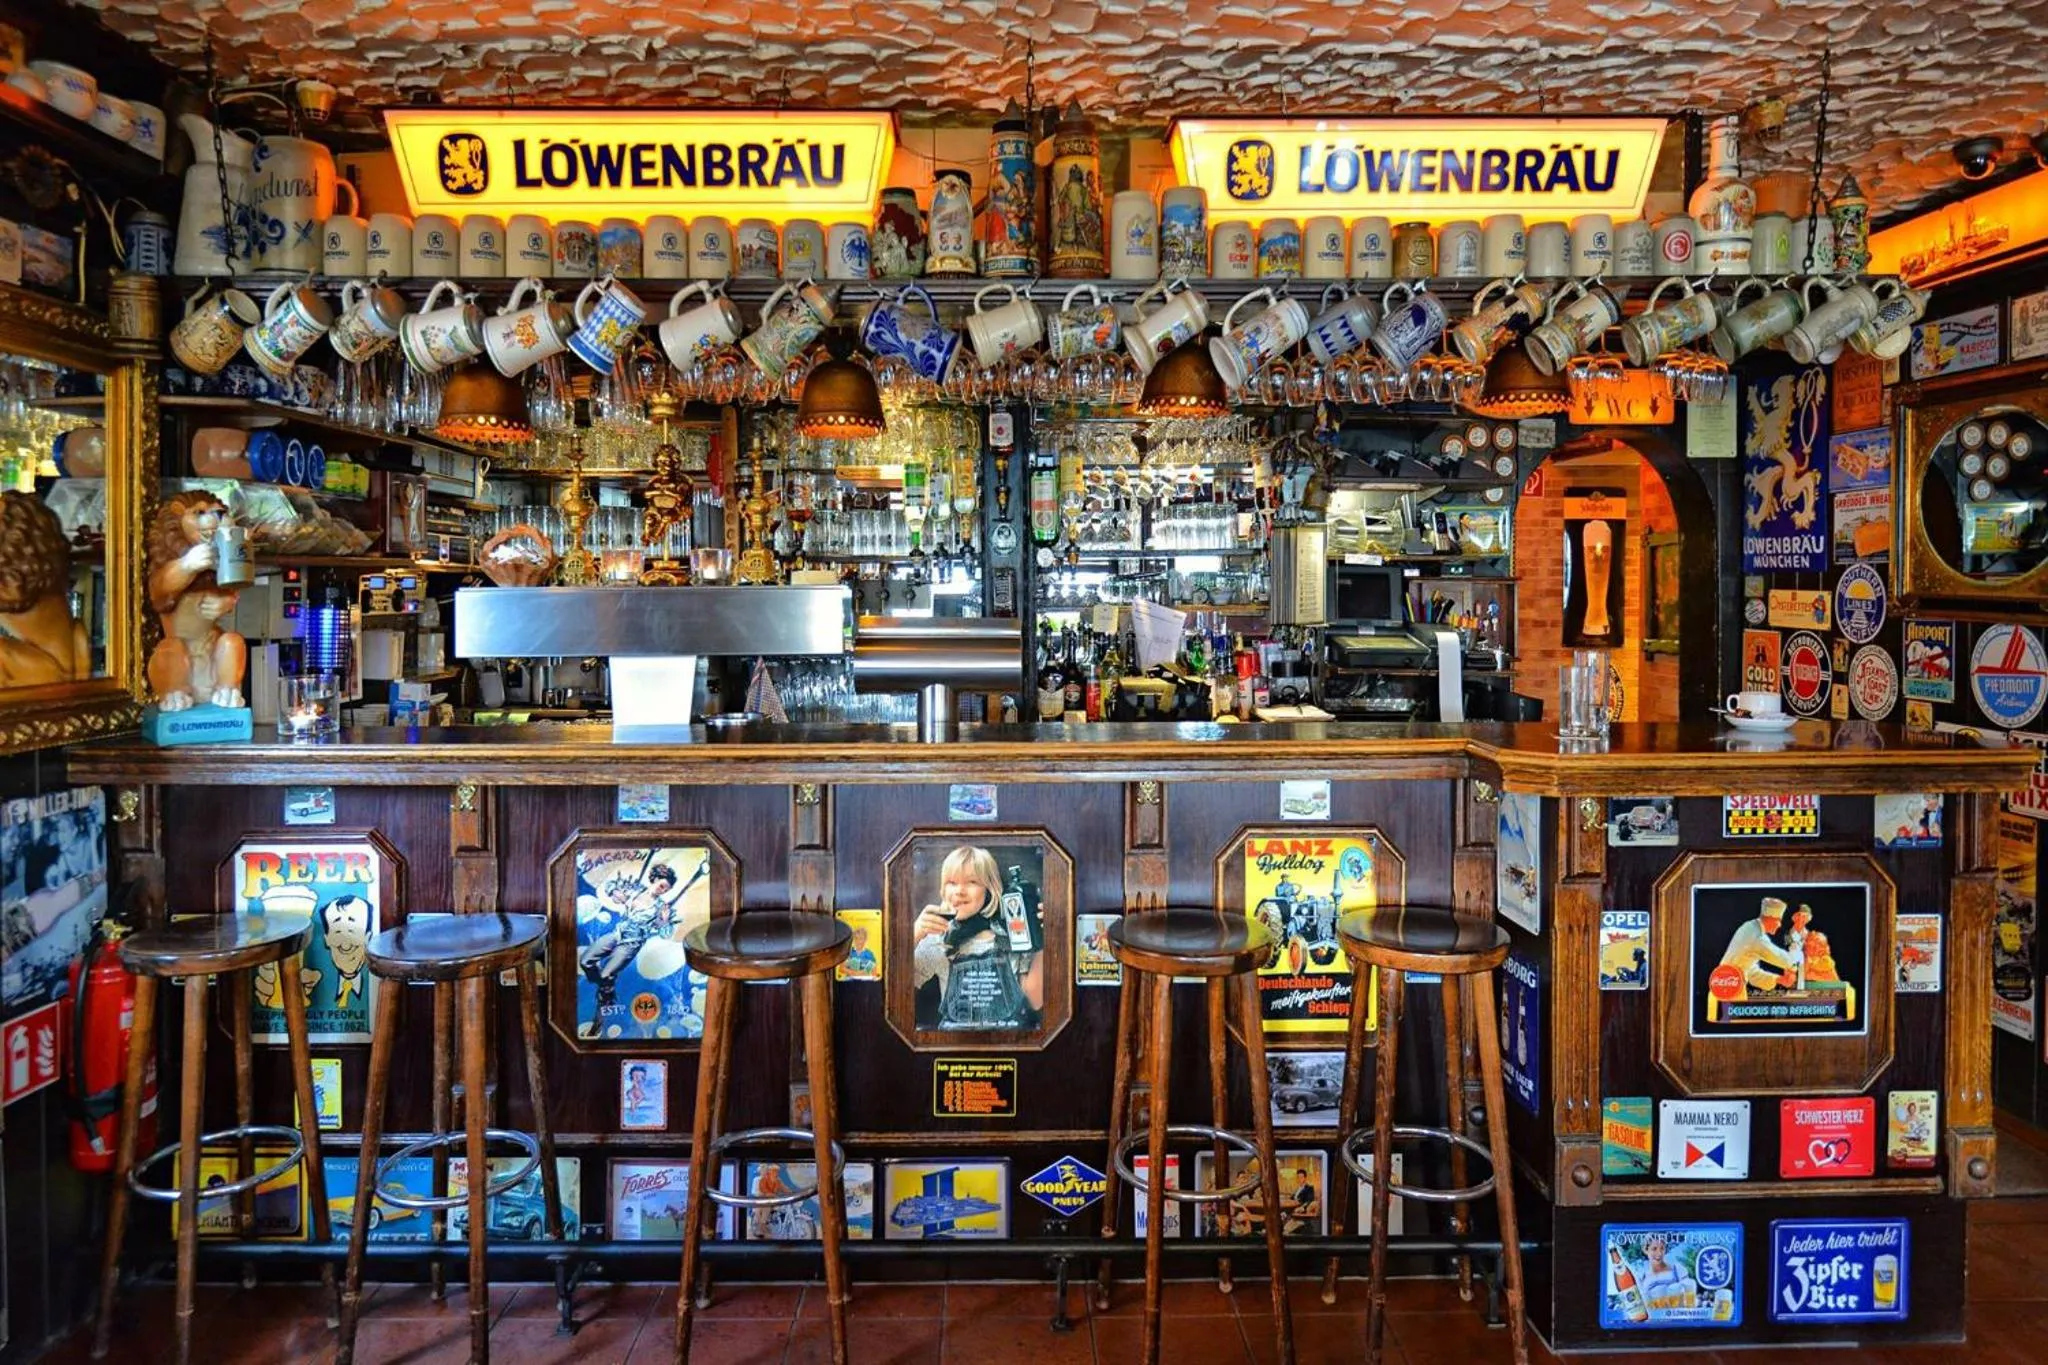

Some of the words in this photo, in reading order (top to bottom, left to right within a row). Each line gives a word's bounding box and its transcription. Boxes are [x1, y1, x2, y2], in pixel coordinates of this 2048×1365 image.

[513, 138, 845, 188] LÖWENBRÄU
[1299, 143, 1620, 194] LÖWENBRÄU
[1743, 534, 1825, 554] LÖWENBRÄU
[1753, 553, 1810, 568] MÜNCHEN
[1839, 565, 1882, 598] SOUTHERN
[1846, 599, 1873, 610] LINES
[1841, 618, 1879, 640] PACIFIC
[1907, 622, 1952, 648] AIRPORT
[1746, 666, 1775, 683] GOLD
[1984, 678, 2034, 693] PIEDMONT
[1730, 795, 1815, 809] SPEEDWELL
[1792, 817, 1812, 827] OIL
[1246, 838, 1334, 858] LANZ
[582, 849, 649, 875] BACARDI
[1256, 854, 1325, 875] Bulldog
[242, 852, 374, 898] BEER
[1603, 913, 1647, 928] OPEL
[326, 1009, 366, 1020] PEOPLE
[1728, 1005, 1769, 1016] DELICIOUS
[1770, 1005, 1788, 1015] AND
[1789, 1004, 1837, 1016] REFRESHING
[1673, 1111, 1711, 1126] MAMMA
[1713, 1111, 1739, 1126] NERO
[622, 1168, 674, 1200] TORRES
[1052, 1196, 1085, 1206] PNEUS
[1783, 1234, 1824, 1254] Jeder
[1826, 1231, 1855, 1249] hier
[1857, 1226, 1898, 1247] trinkt
[1782, 1255, 1864, 1312] Zipfer
[1807, 1284, 1859, 1309] Bier
